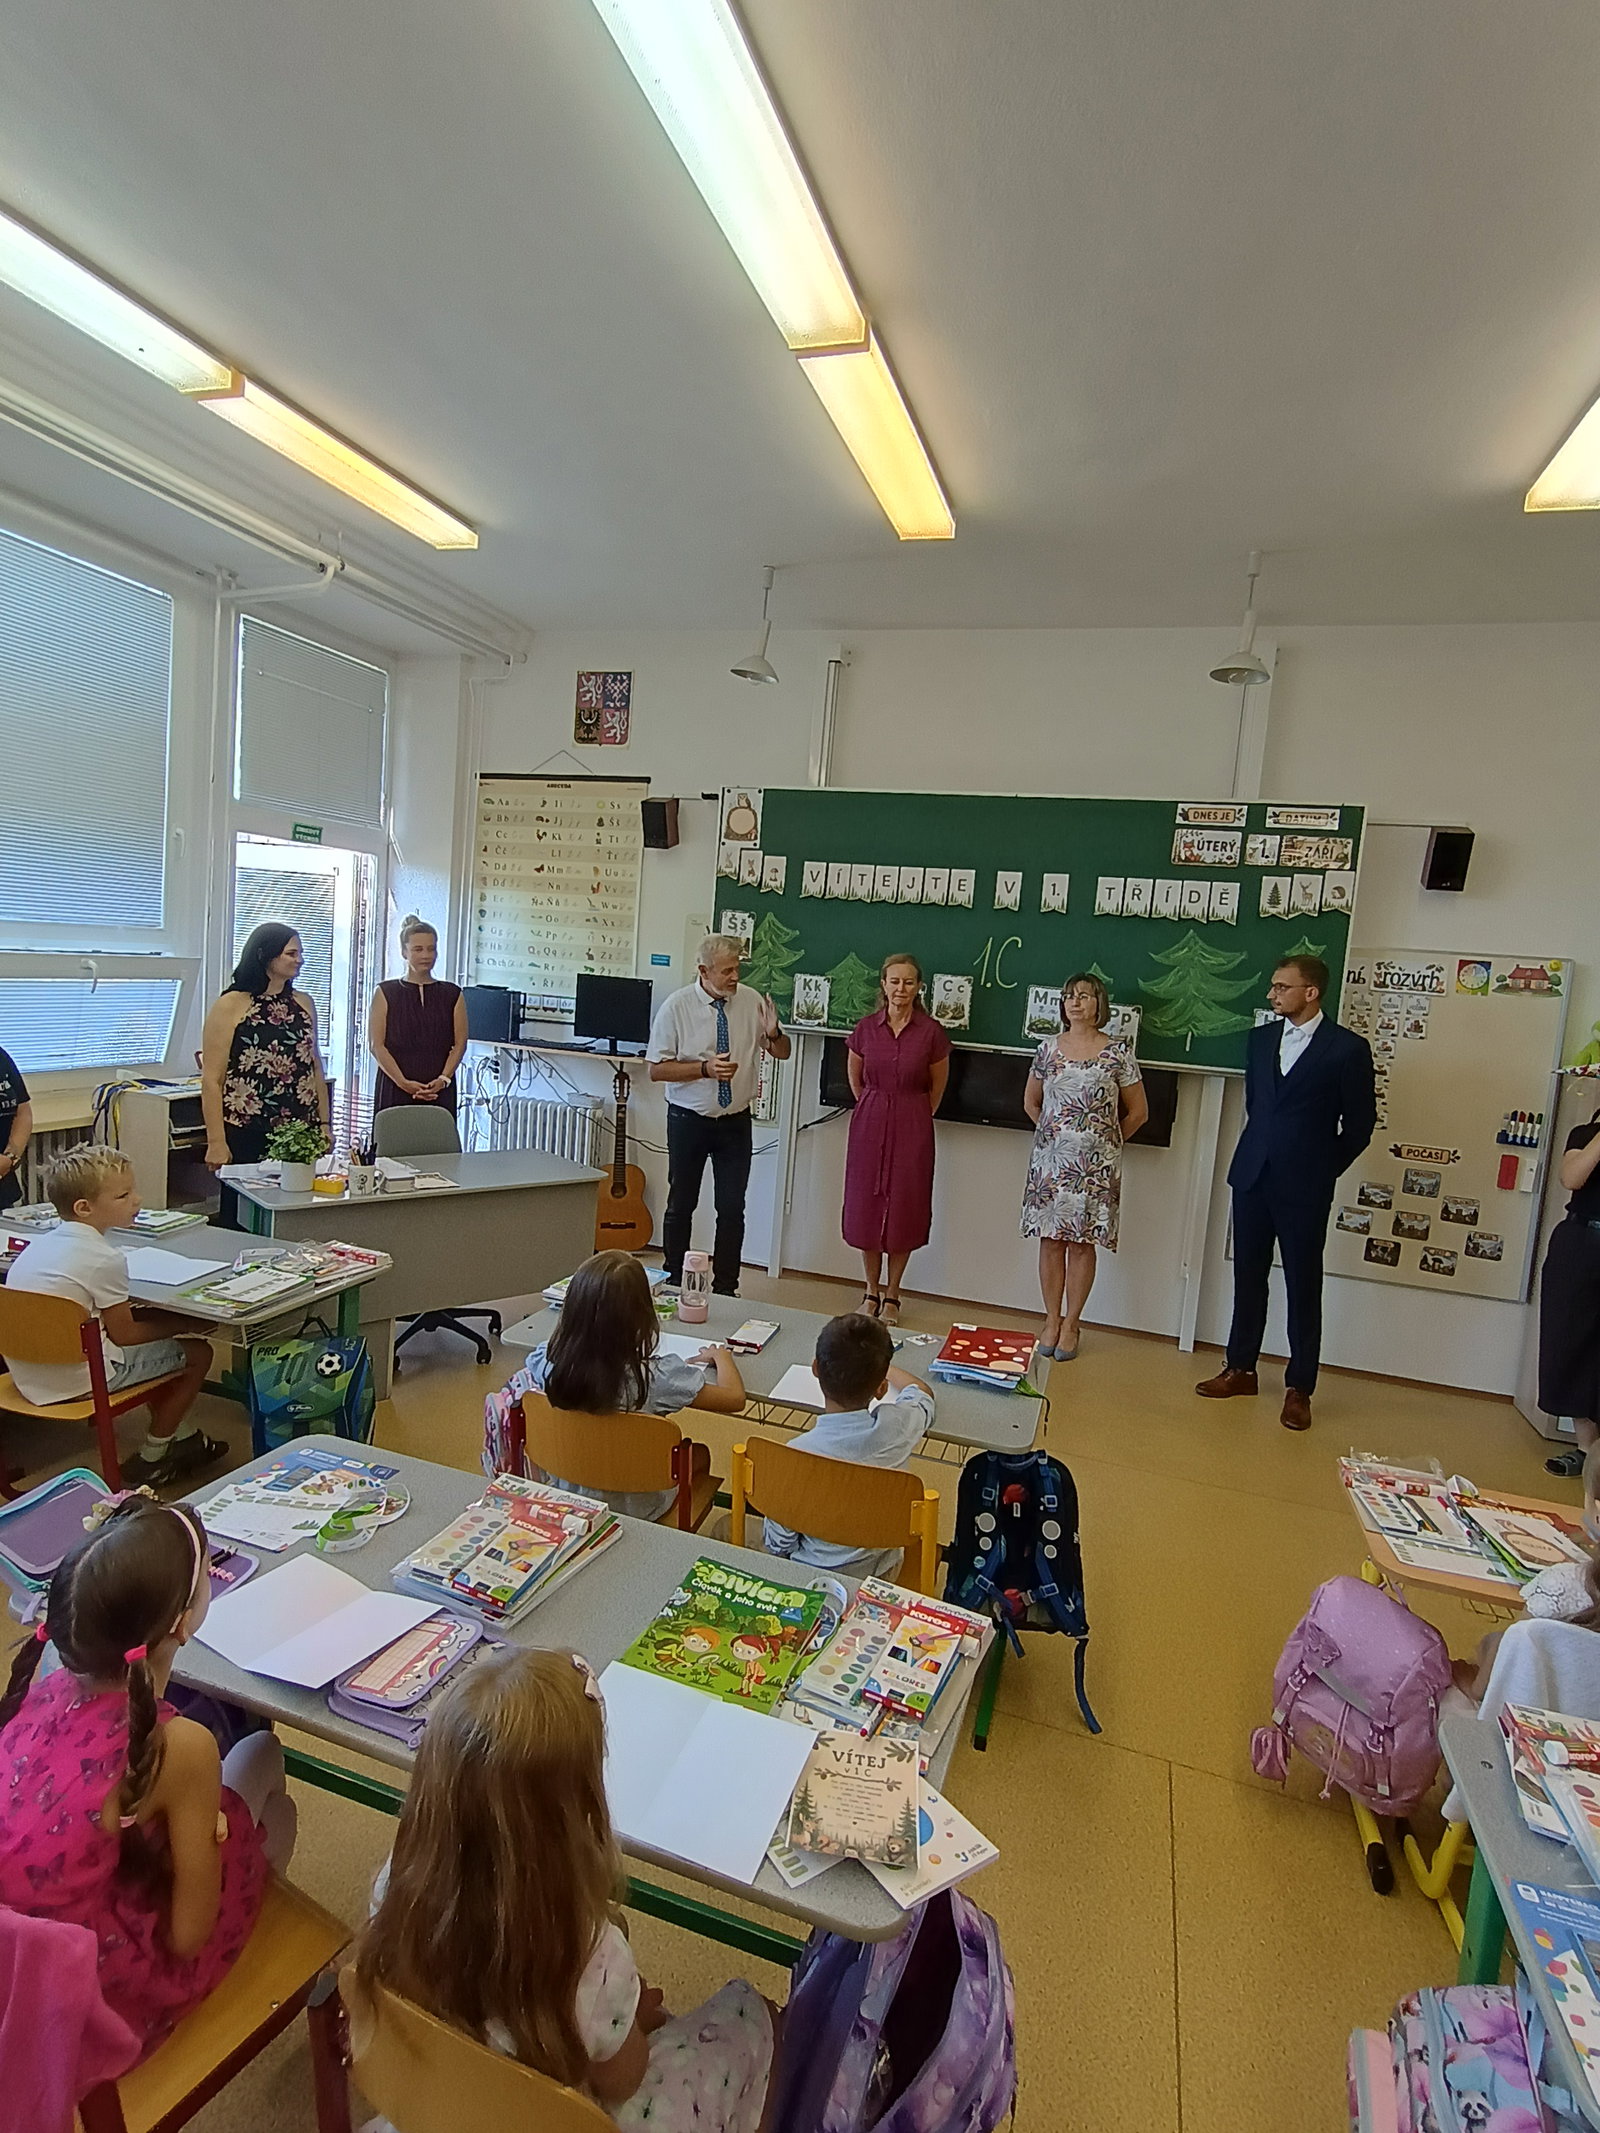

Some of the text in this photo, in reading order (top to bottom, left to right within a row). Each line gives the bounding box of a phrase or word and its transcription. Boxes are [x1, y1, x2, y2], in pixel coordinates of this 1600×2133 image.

[1193, 810, 1231, 821] DNES JE
[1197, 835, 1237, 853] ÚTERÝ
[1305, 843, 1334, 860] ZÁŘÍ
[810, 868, 1230, 906] VÍTEJTE V 1. TŘÍDĚ
[1406, 1147, 1444, 1161] POČASÍ
[257, 1346, 280, 1356] PRO
[732, 1593, 755, 1607] jeho
[756, 1601, 778, 1613] svět
[832, 1749, 887, 1769] VÍTEJ
[864, 1769, 872, 1777] C
